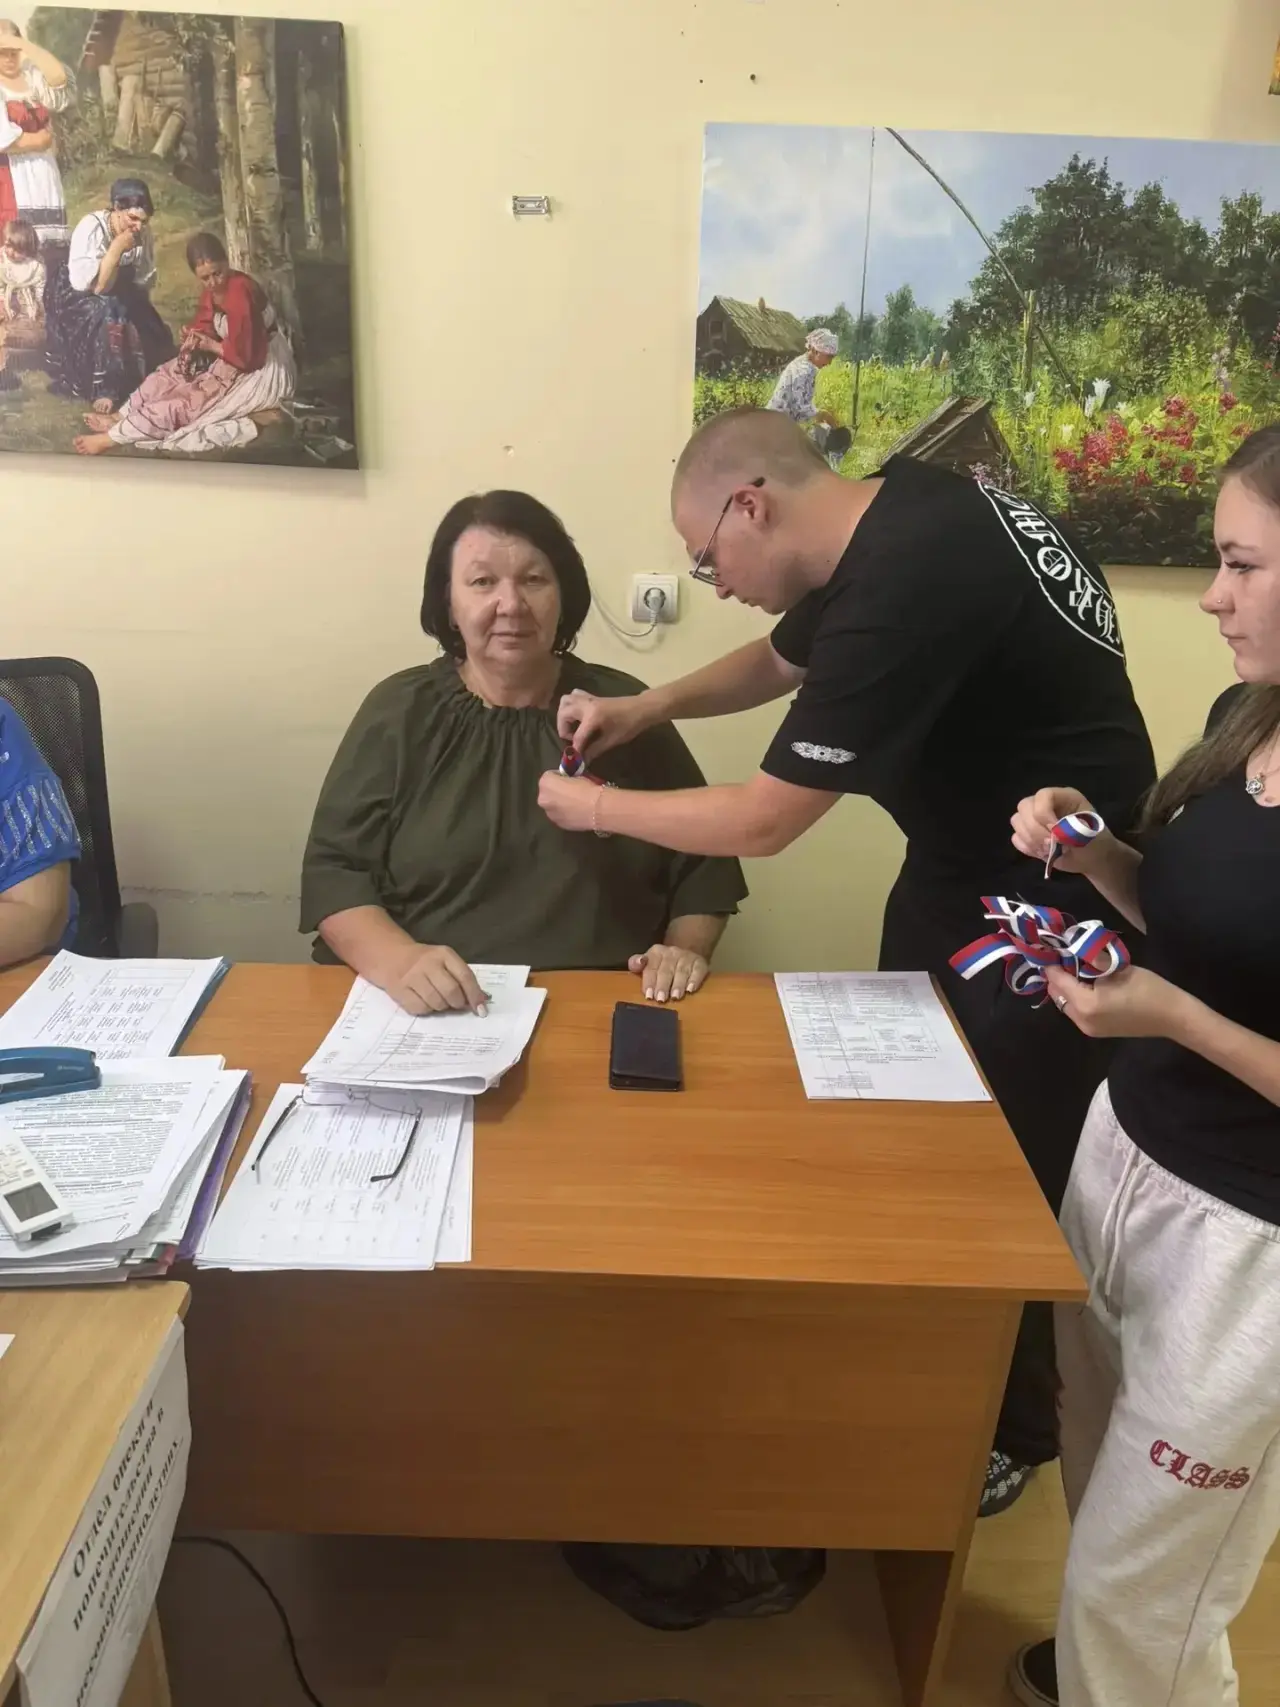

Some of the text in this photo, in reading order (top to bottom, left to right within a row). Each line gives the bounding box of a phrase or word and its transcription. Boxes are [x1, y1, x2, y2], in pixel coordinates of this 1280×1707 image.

[73, 1425, 157, 1631] попечительства
[157, 1407, 164, 1424] в
[74, 1399, 153, 1578] Отдел опеки и
